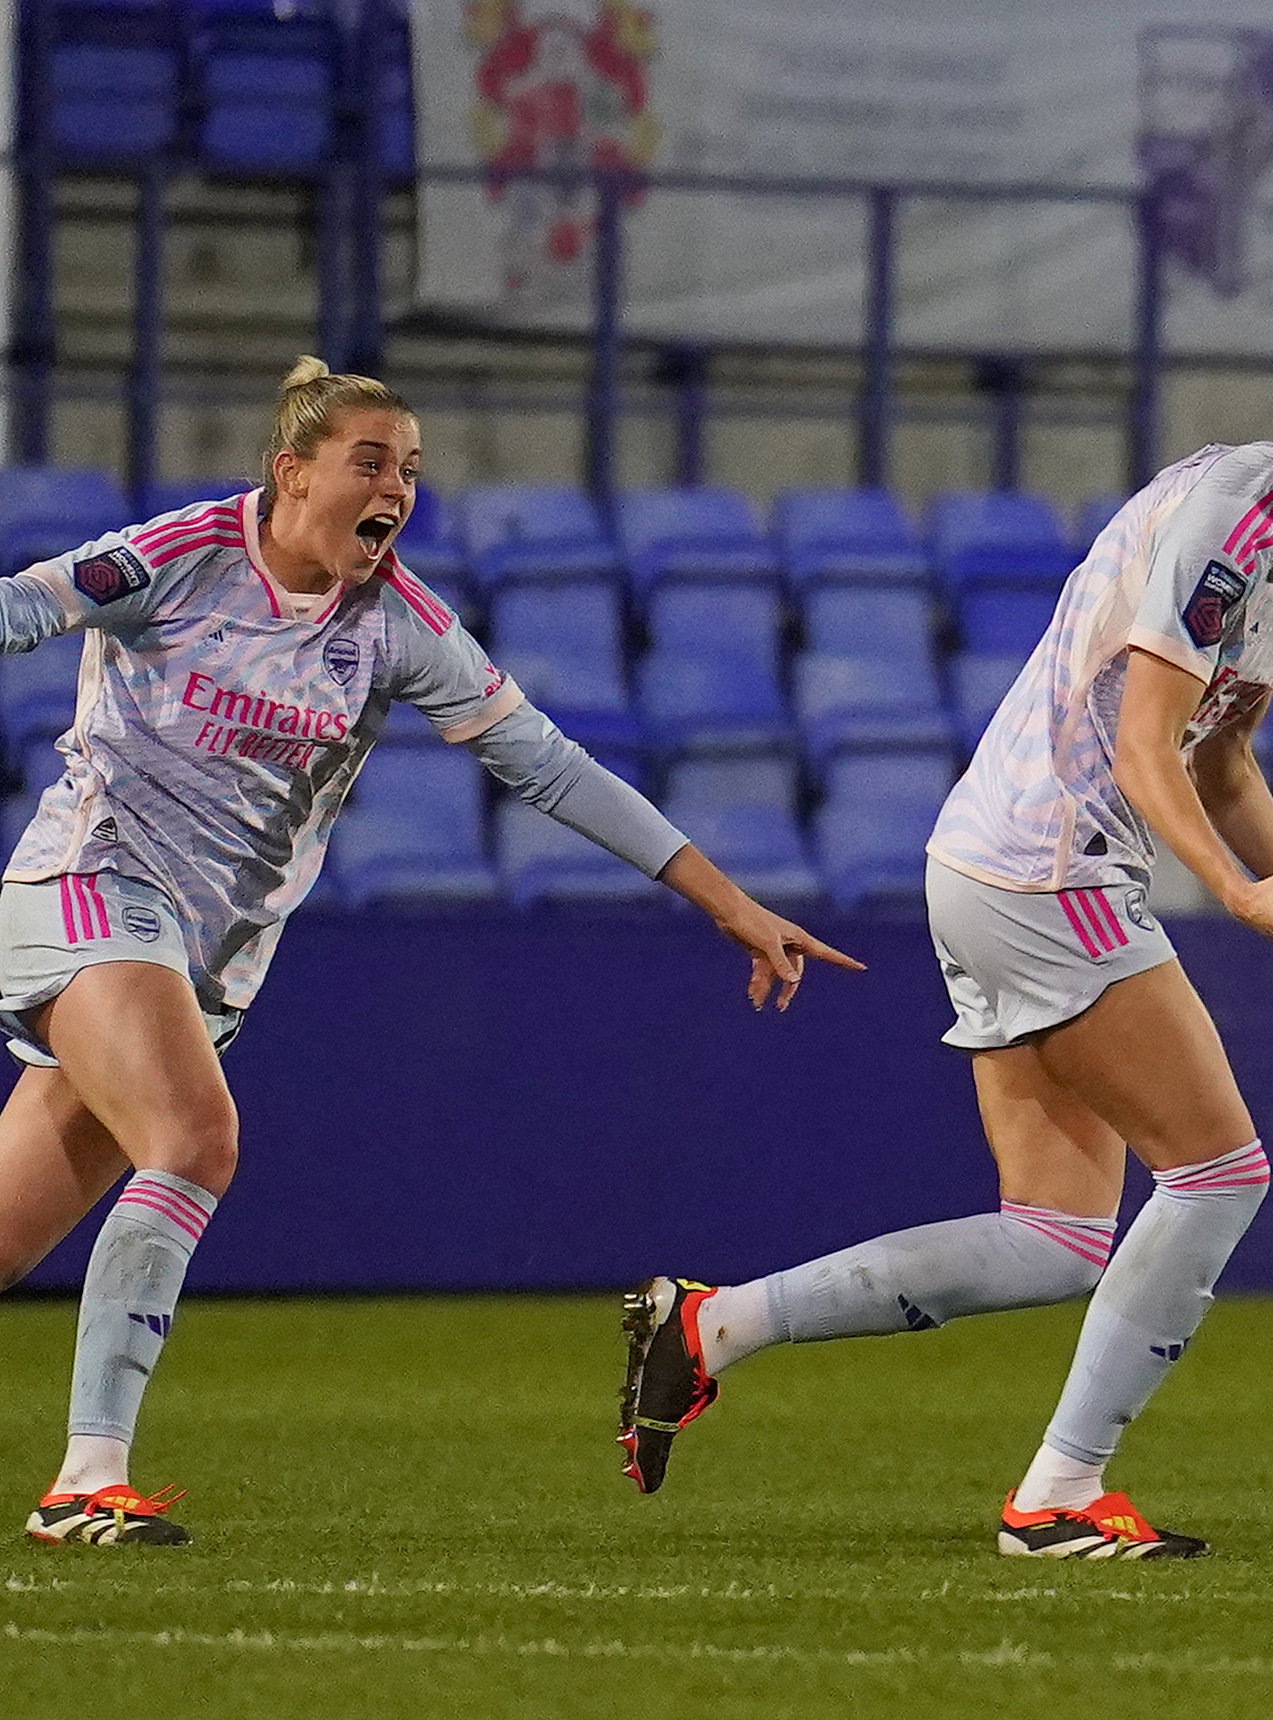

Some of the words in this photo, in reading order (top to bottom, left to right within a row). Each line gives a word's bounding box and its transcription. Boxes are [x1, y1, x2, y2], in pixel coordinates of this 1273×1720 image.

[181, 671, 349, 741] Emirates
[194, 721, 239, 756] FLY
[238, 732, 317, 769] BETTER
